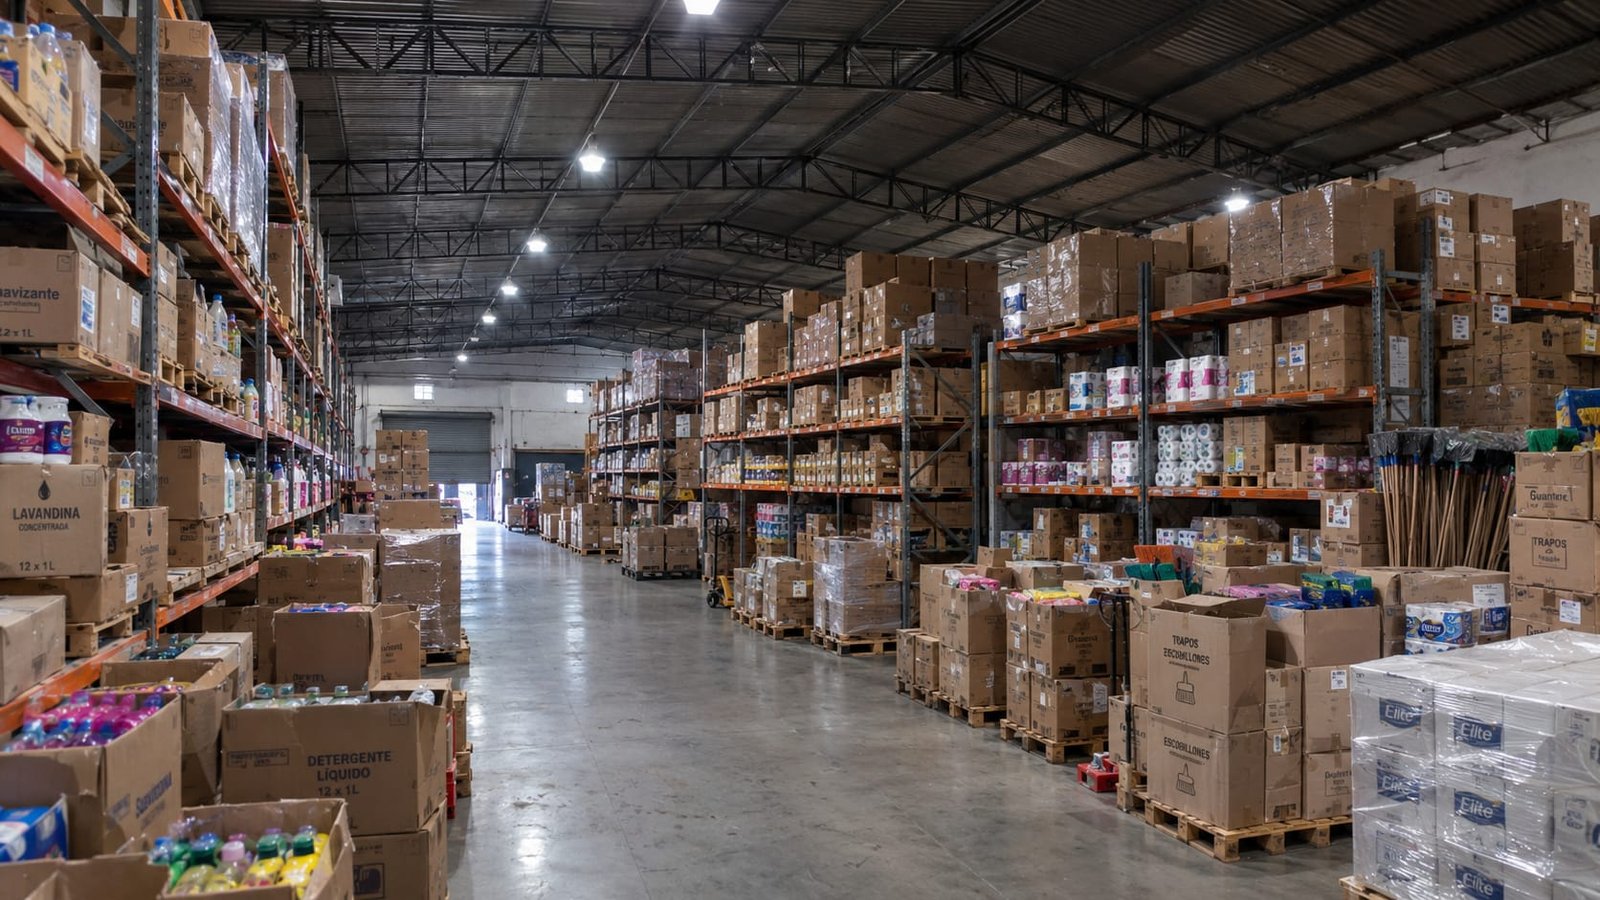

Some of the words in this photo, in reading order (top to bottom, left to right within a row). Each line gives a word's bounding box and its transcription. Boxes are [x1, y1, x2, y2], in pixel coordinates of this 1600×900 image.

[13, 507, 80, 520] LAVANDINA
[18, 522, 69, 531] CONCENTRADA
[1533, 537, 1567, 549] TRAPOS
[19, 561, 31, 571] 12
[42, 561, 55, 570] 1L
[1385, 704, 1413, 722] Elite
[1461, 722, 1492, 741] Elite
[1164, 736, 1210, 760] ESCOBILLONES
[307, 750, 391, 767] DETERGENTE
[317, 766, 370, 782] LÍQUIDO
[318, 786, 331, 797] 12
[335, 788, 341, 796] x
[345, 785, 359, 795] 1L
[1461, 797, 1493, 819] Elite
[1463, 872, 1493, 896] Elite
